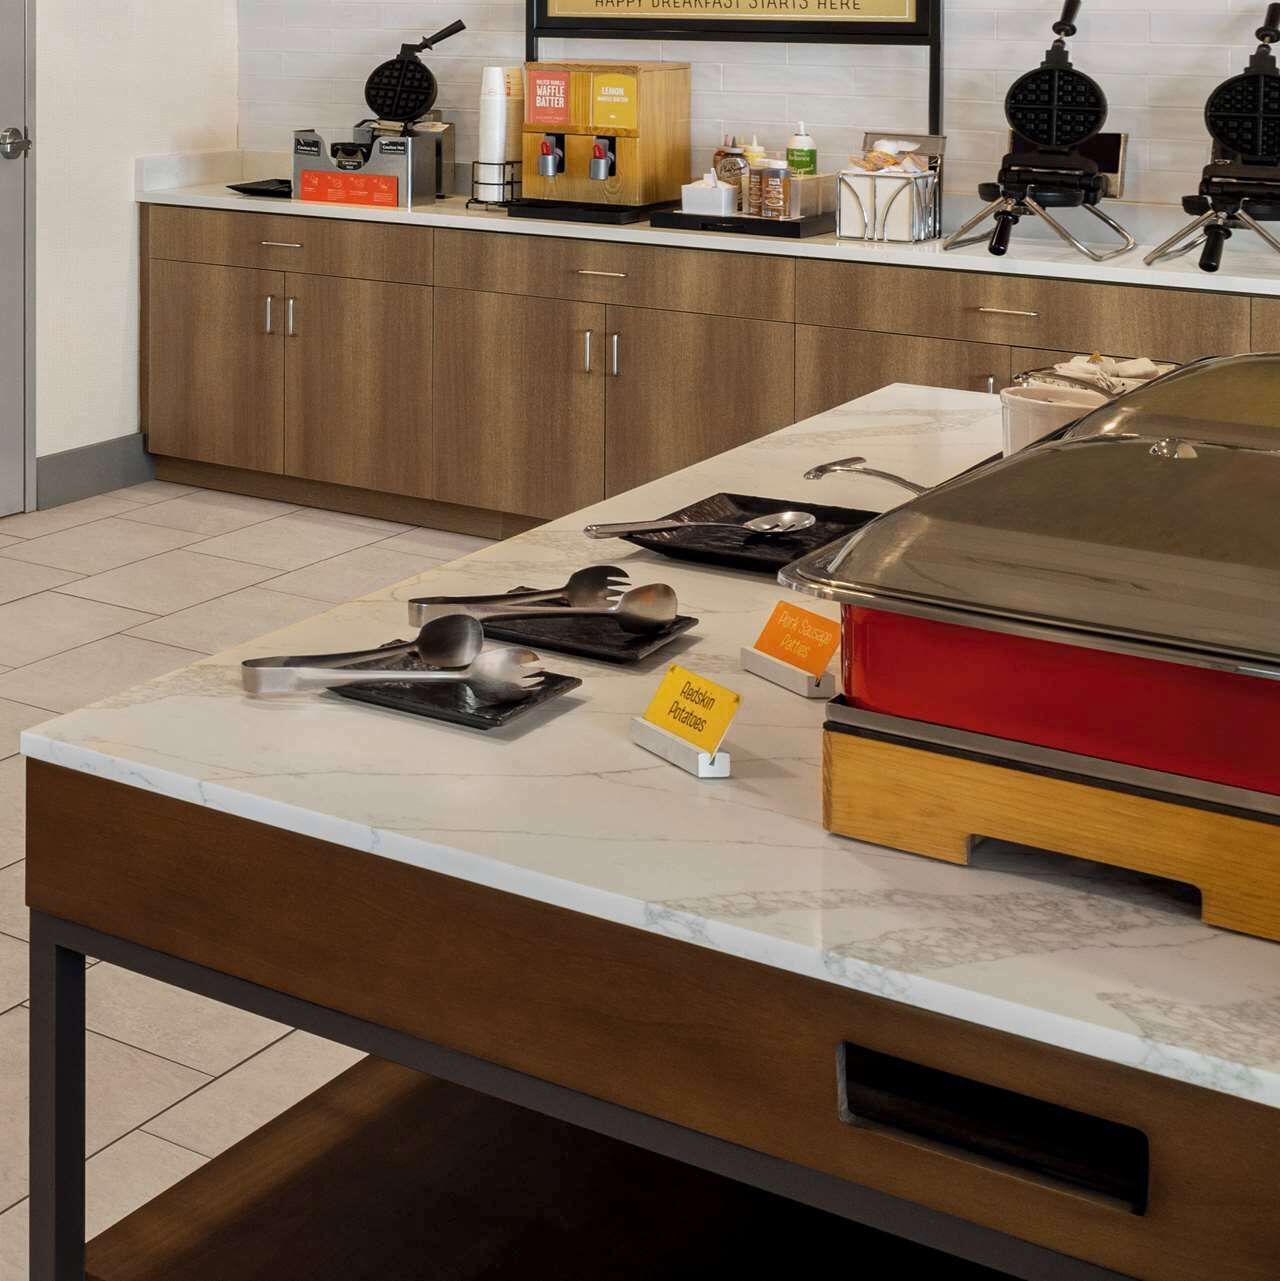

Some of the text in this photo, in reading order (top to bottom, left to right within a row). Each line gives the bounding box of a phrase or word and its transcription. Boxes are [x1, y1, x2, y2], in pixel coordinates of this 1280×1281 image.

[536, 85, 565, 97] WAFFLE
[536, 96, 565, 108] BATTER
[601, 88, 625, 96] LEMON
[778, 610, 833, 648] Pork Sausage
[780, 633, 811, 658] Patties
[679, 681, 715, 711] Redskin
[667, 700, 707, 732] Potatoes
